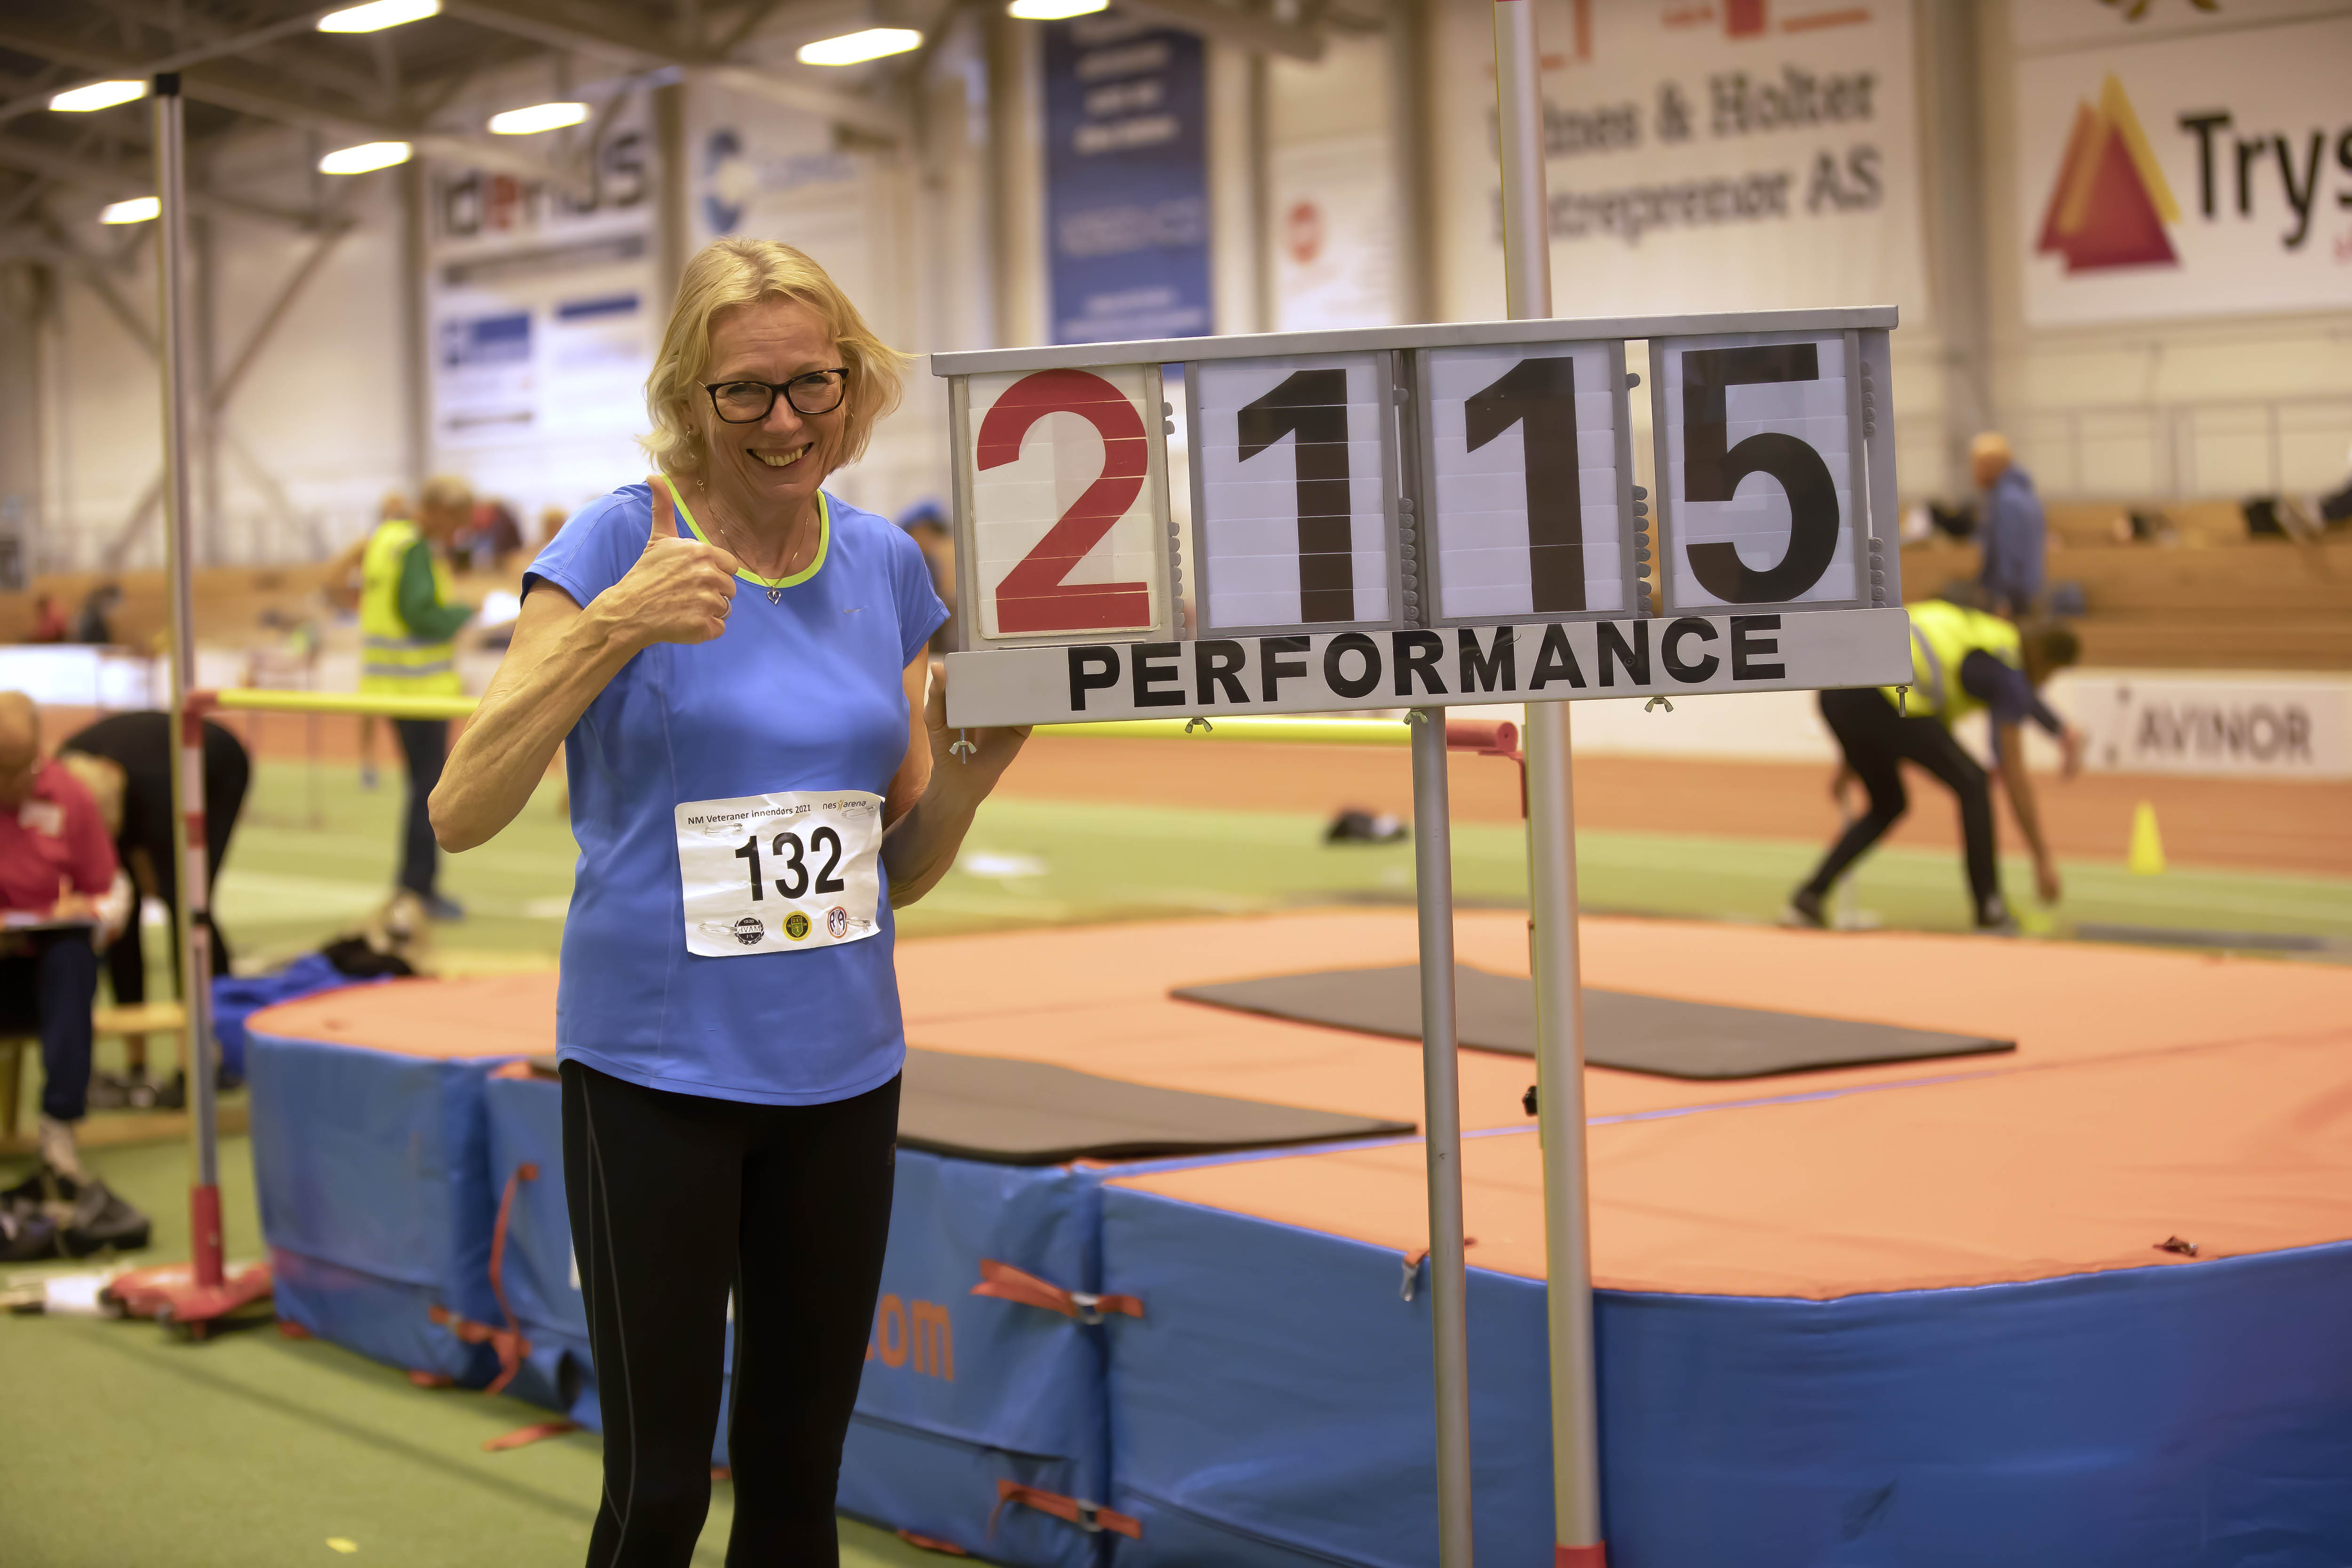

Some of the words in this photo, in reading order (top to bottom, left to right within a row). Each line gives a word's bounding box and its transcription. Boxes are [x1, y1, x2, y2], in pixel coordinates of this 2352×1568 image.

[1805, 145, 1885, 212] AS
[1068, 614, 1787, 711] PERFORMANCE
[2138, 703, 2313, 762] AVINOR
[688, 816, 704, 825] NM
[706, 812, 749, 823] Veteraner
[751, 807, 793, 818] innendørs
[795, 804, 811, 814] 2021
[735, 826, 844, 901] 132
[865, 1293, 955, 1383] om
